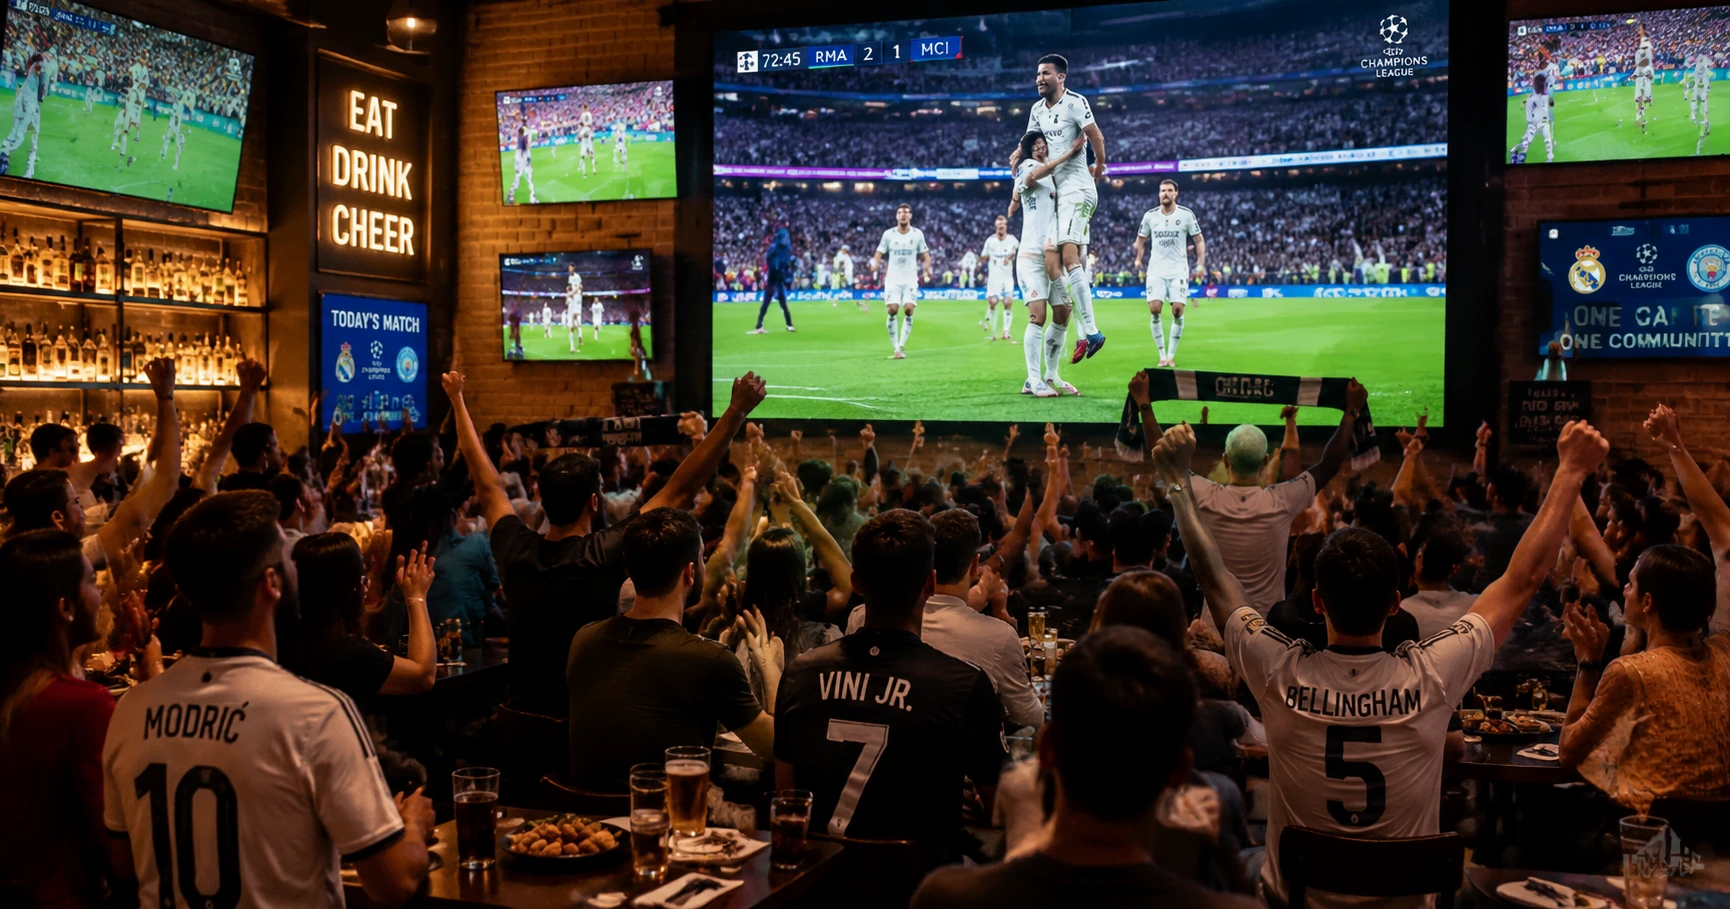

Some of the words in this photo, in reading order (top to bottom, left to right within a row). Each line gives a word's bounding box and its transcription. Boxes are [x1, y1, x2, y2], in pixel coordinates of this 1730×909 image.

[762, 52, 801, 68] 72:45
[815, 50, 848, 63] RMA
[863, 47, 874, 61] 2
[893, 44, 901, 58] 1
[921, 41, 949, 56] MCI
[1360, 56, 1428, 69] CHAMPIONS
[1375, 68, 1414, 78] LEAGUE
[349, 89, 398, 139] EAT
[332, 144, 413, 200] DRINK
[332, 204, 415, 256] CHEER
[331, 309, 380, 330] TODAY'S
[383, 314, 420, 333] MATCH
[1573, 305, 1623, 327] ONE
[1560, 333, 1603, 350] ONE
[819, 671, 870, 701] VINI
[874, 676, 913, 712] JR.
[1285, 685, 1422, 717] BELLINGHAM
[143, 701, 249, 744] MODRIĆ
[826, 718, 890, 837] 7
[1325, 725, 1386, 827] 5
[134, 762, 242, 909] 10
